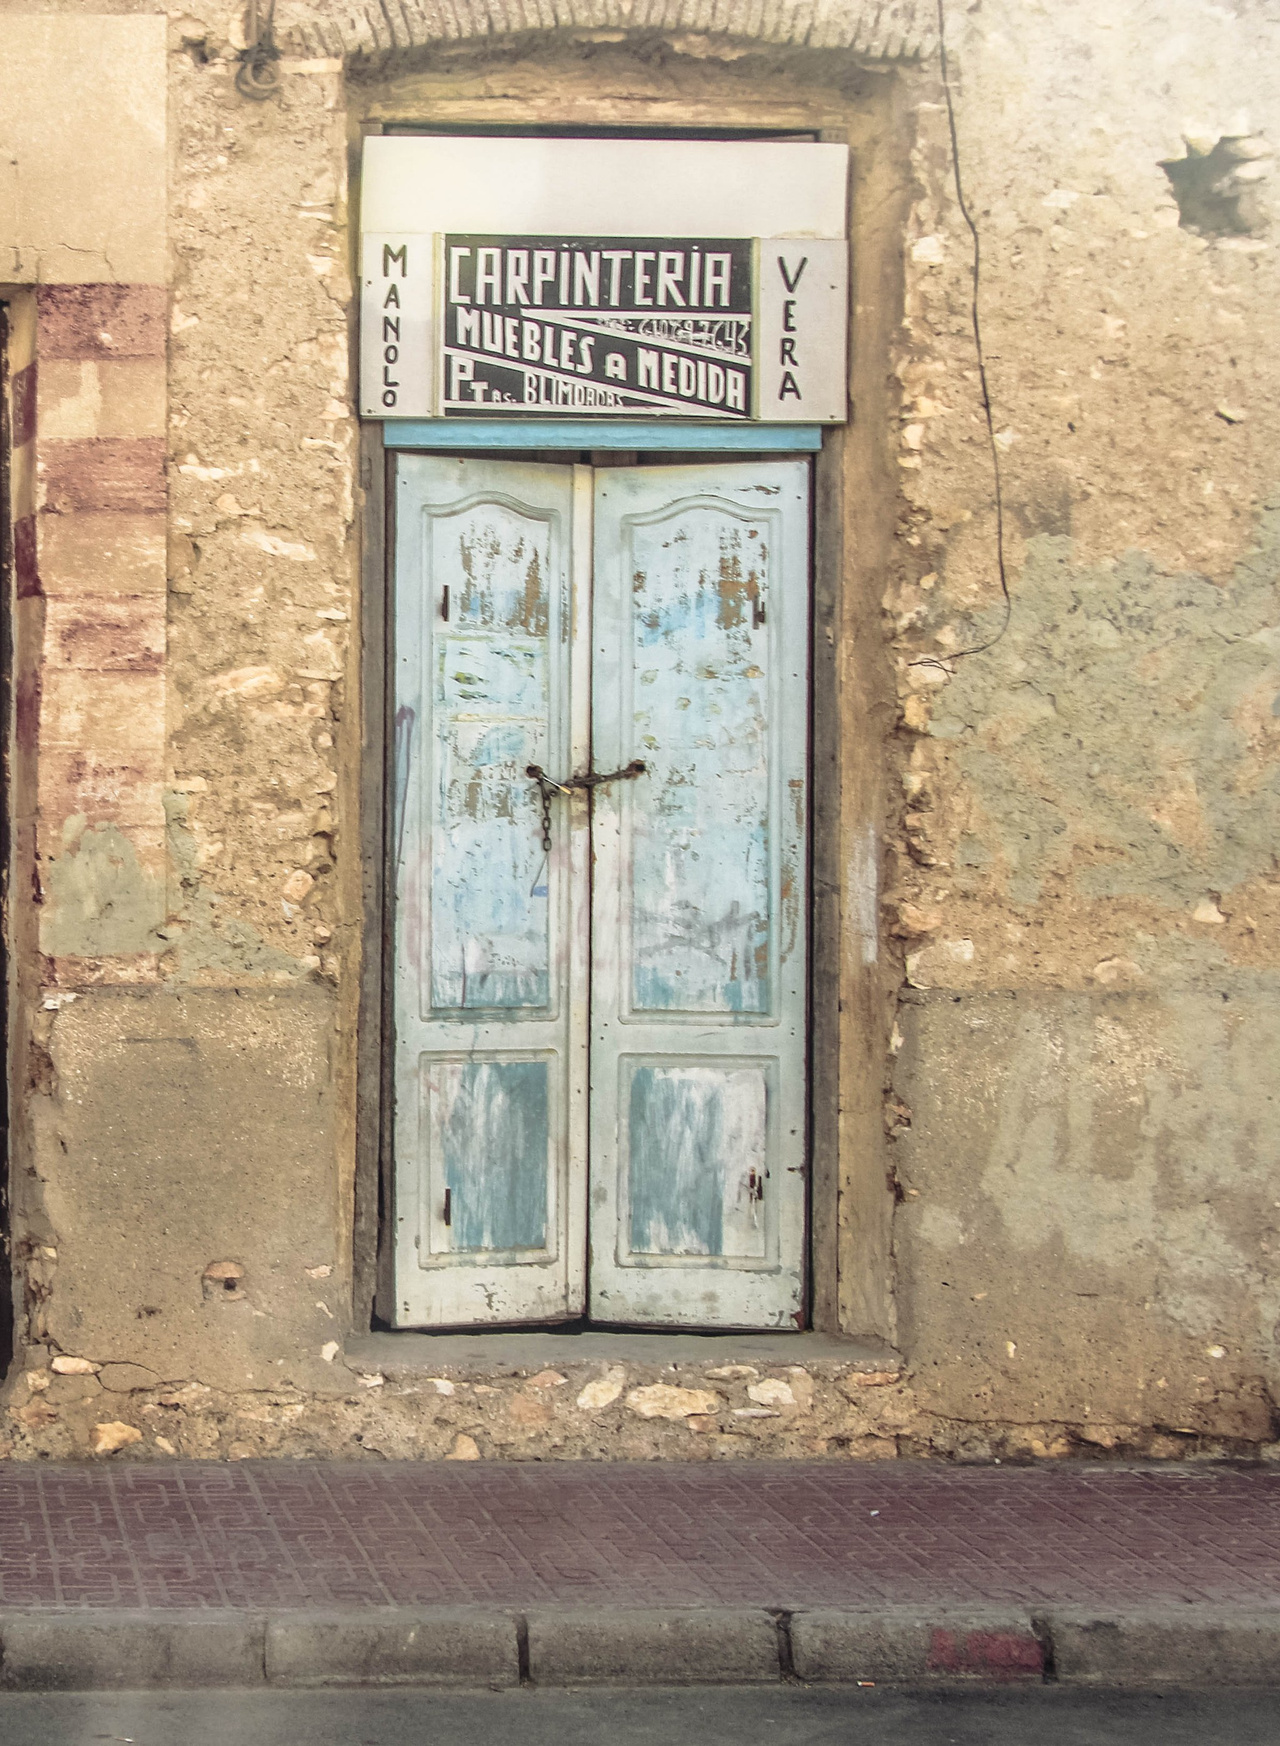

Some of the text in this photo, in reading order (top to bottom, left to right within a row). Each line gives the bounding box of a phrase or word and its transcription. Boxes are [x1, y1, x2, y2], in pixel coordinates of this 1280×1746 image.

[382, 243, 408, 408] MANOLO
[456, 305, 595, 375] MUEBLES
[636, 346, 747, 411] MEDIDA
[777, 255, 808, 401] VERA
